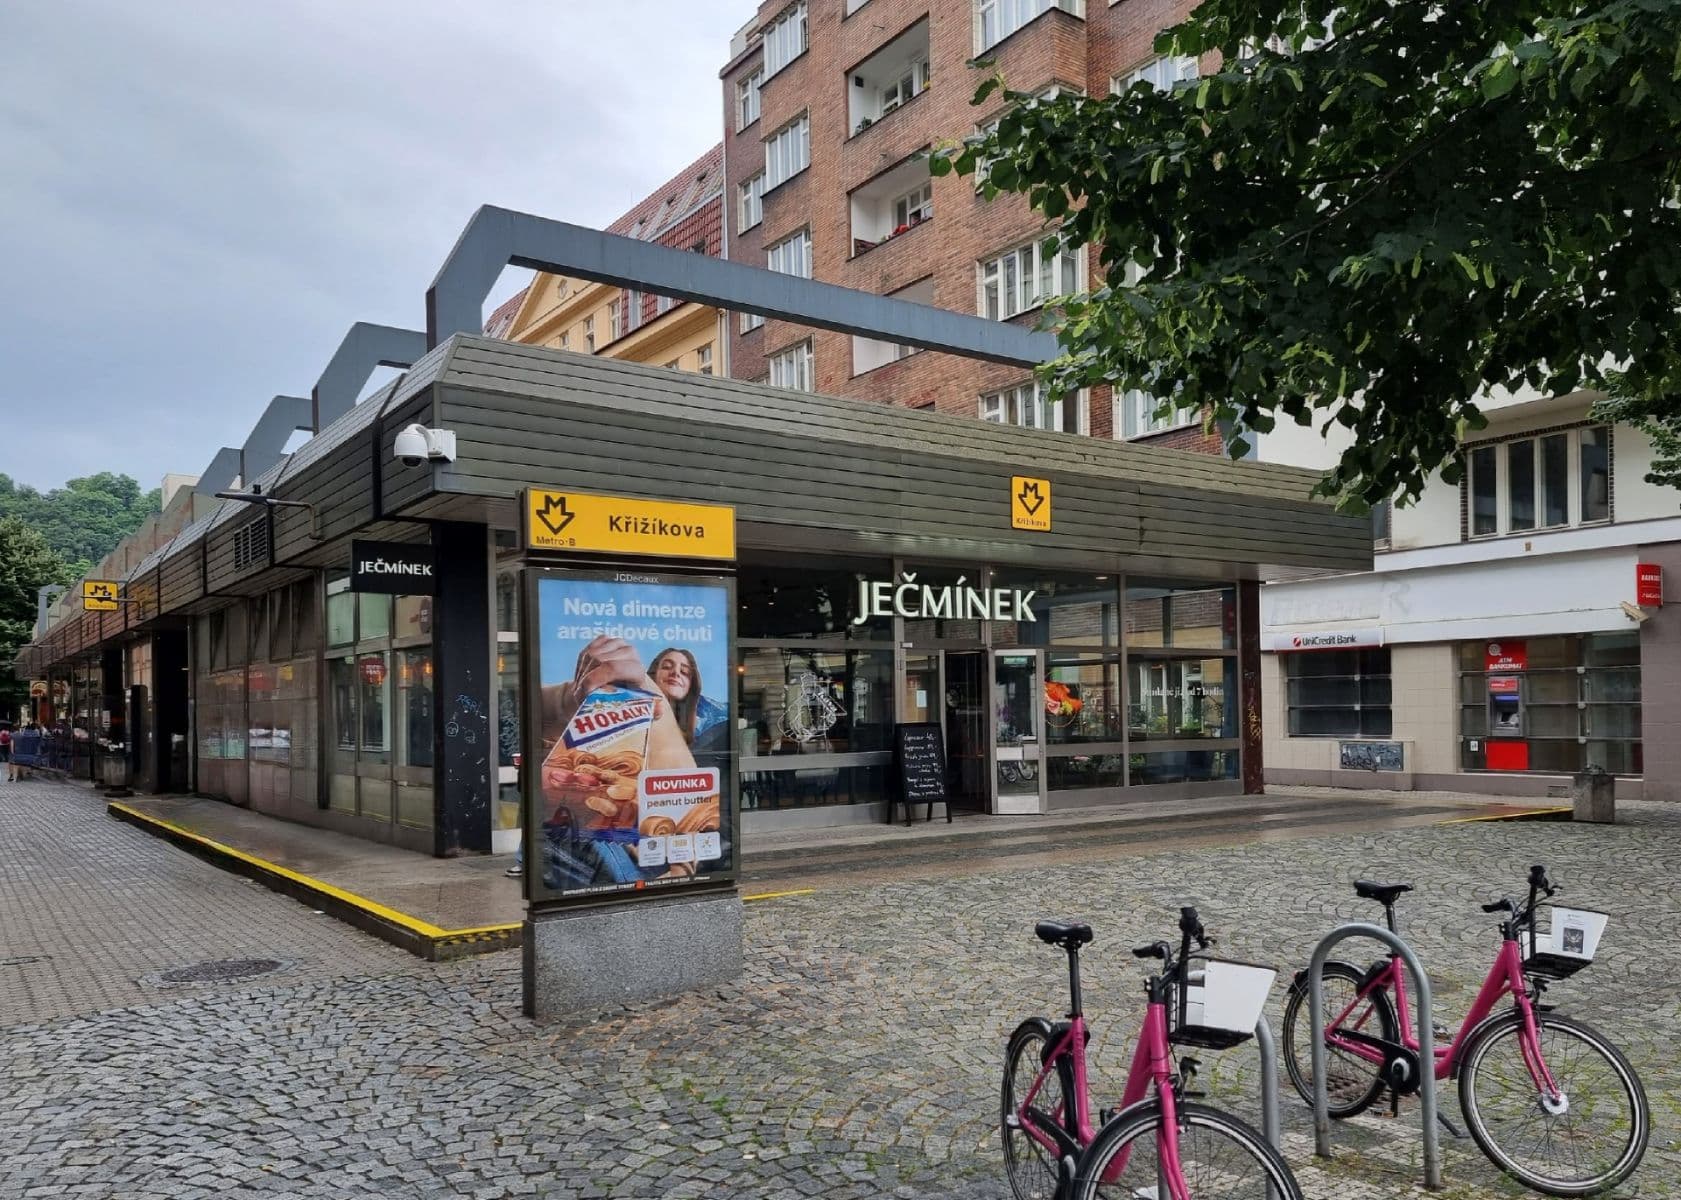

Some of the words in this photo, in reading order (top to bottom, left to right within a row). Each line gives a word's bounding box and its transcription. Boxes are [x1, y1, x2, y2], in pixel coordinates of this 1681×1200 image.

[609, 515, 705, 538] Křižíkova
[358, 558, 433, 576] JEČMÍNEK
[613, 573, 660, 584] JCDecaux
[853, 572, 1037, 625] JEČMÍNEK
[564, 598, 617, 617] Nová
[622, 600, 706, 619] dimenze
[557, 622, 659, 641] arašídové
[663, 624, 713, 641] chuti
[1302, 635, 1336, 646] UniCredit
[1337, 634, 1357, 644] Bank
[575, 706, 651, 734] HORALKY
[653, 778, 708, 791] NOVINKA
[647, 798, 682, 810] peanut
[684, 796, 713, 806] butter
